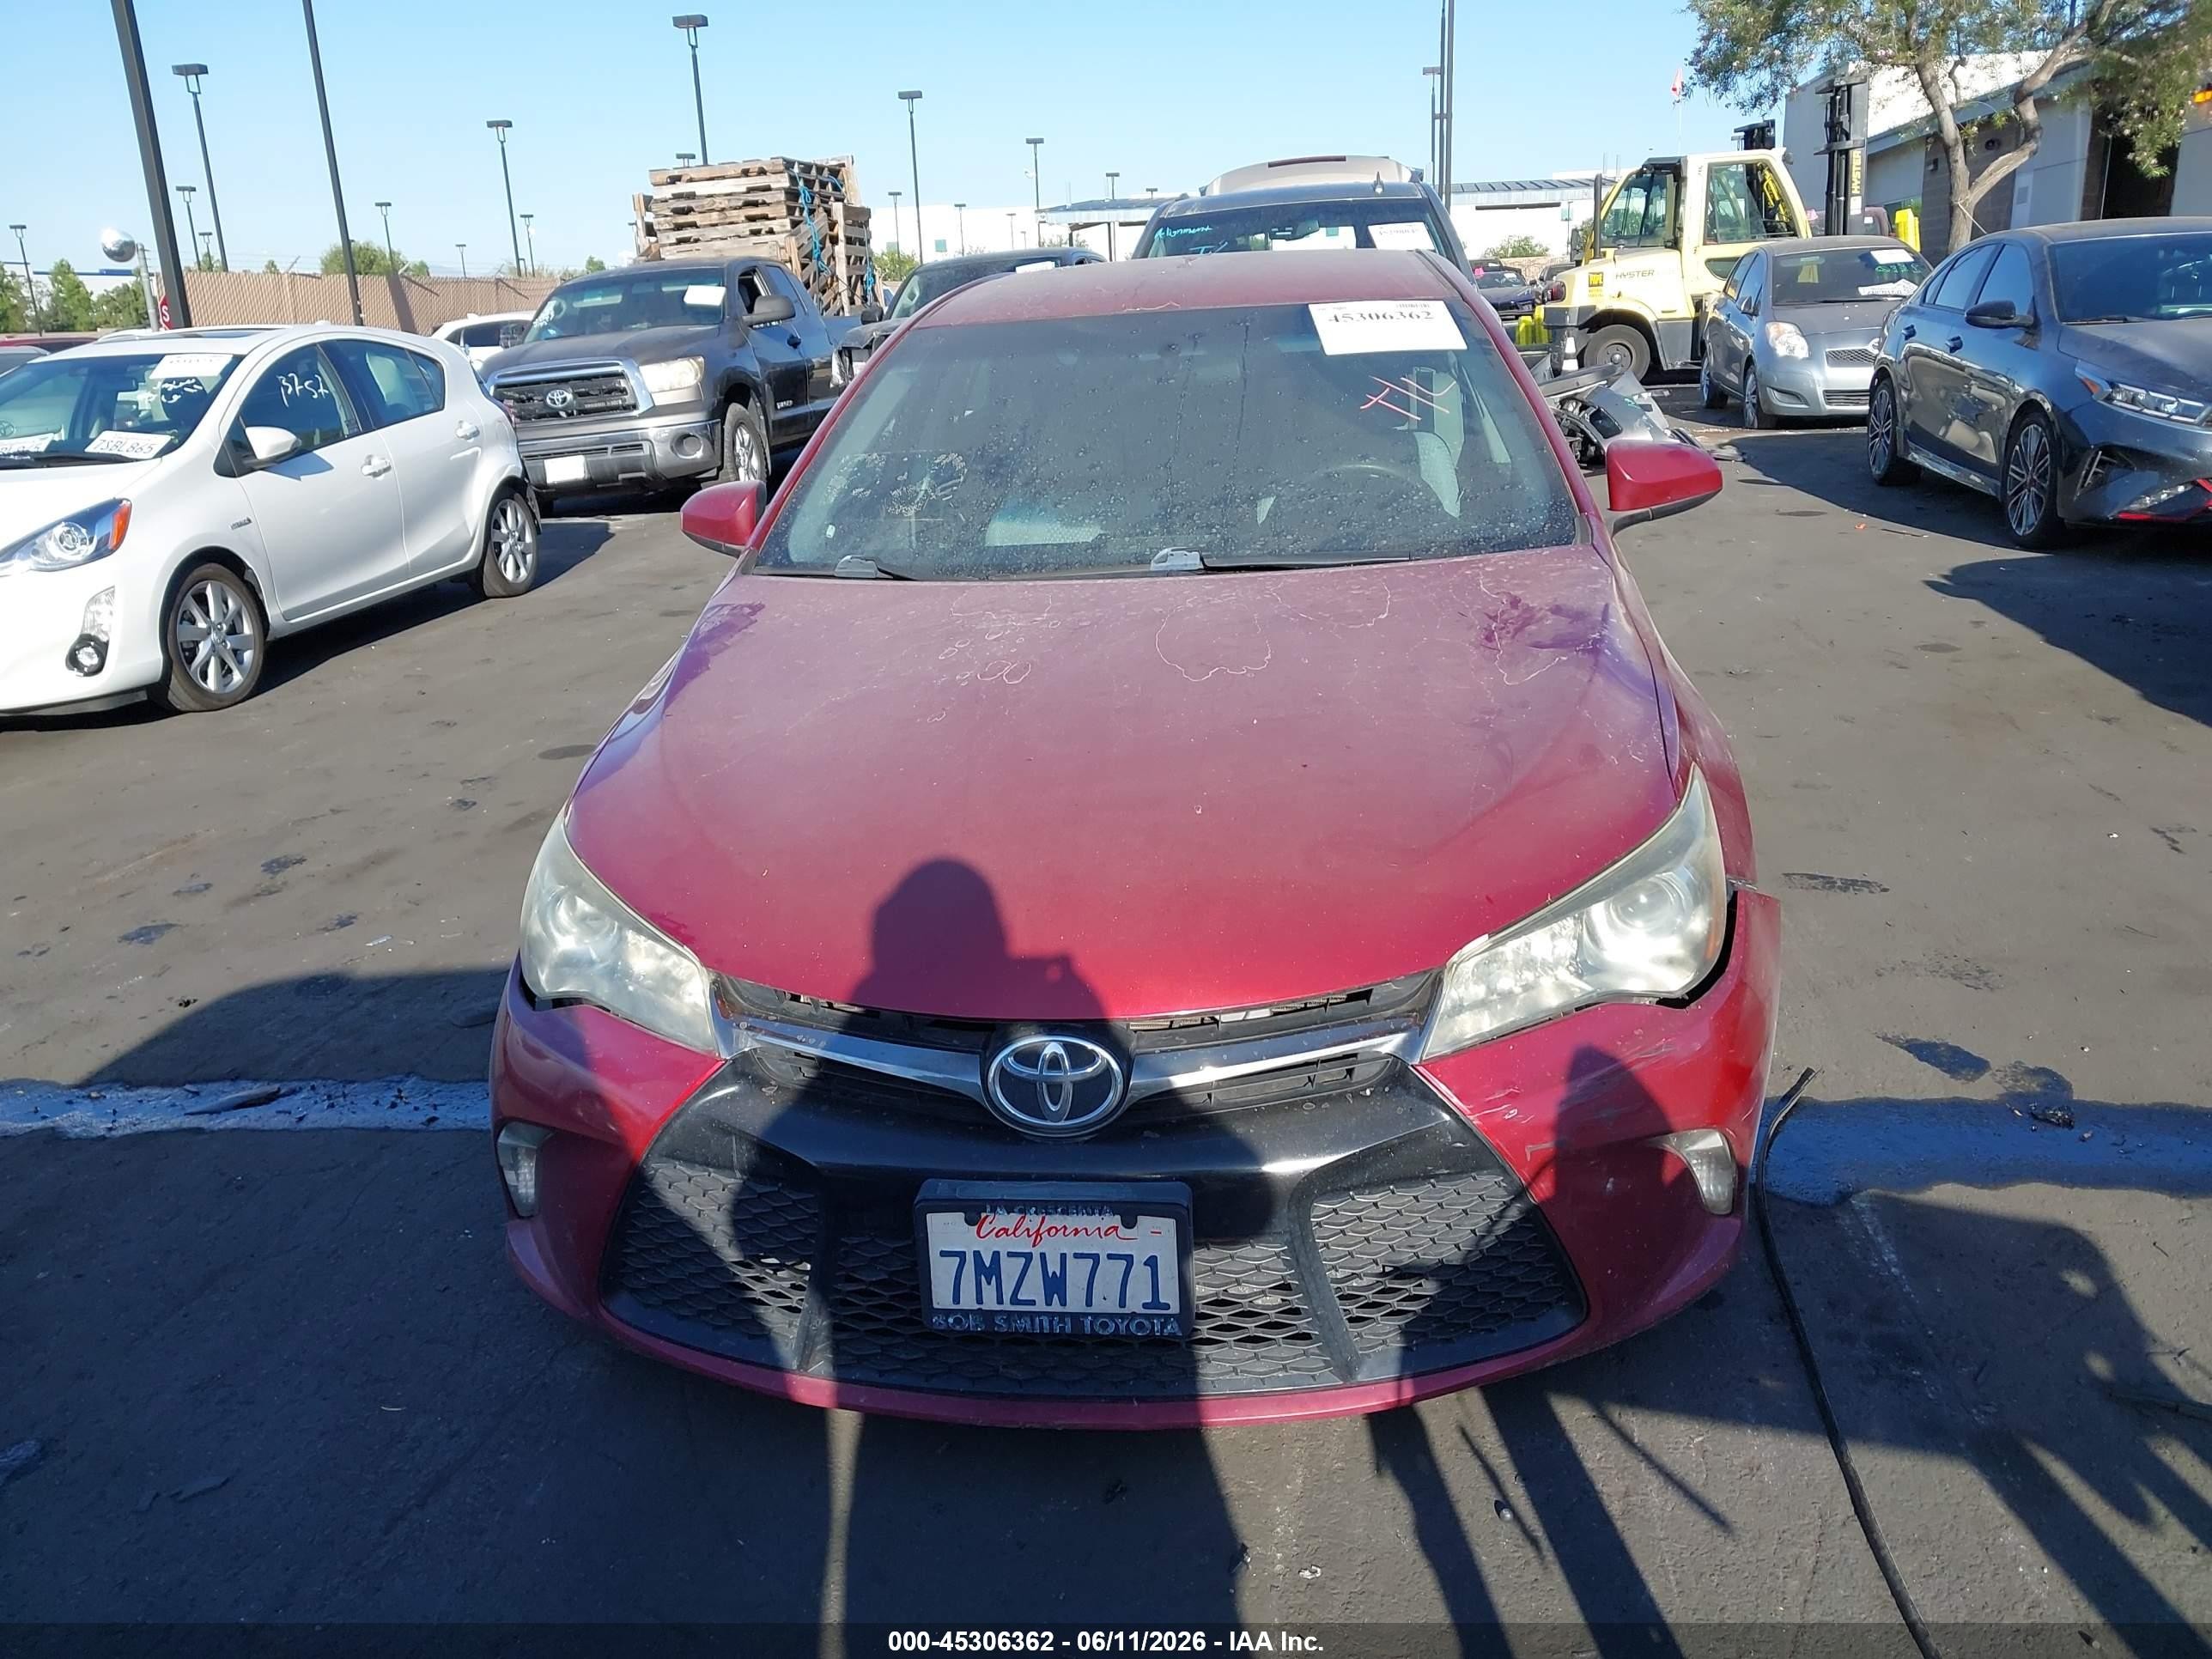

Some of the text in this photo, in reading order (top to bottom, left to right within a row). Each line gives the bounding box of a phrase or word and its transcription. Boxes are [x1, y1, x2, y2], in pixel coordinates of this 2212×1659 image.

[1851, 150, 1862, 194] HYSTER
[1154, 225, 1212, 240] Alignment
[1615, 270, 1655, 279] HYSTER
[1328, 310, 1435, 324] 45306362
[93, 439, 157, 453] 7SBL865
[975, 1214, 1139, 1248] California
[939, 1250, 1170, 1310] 7MZW771
[932, 1313, 1182, 1335] BOB SMITH TOYOTA
